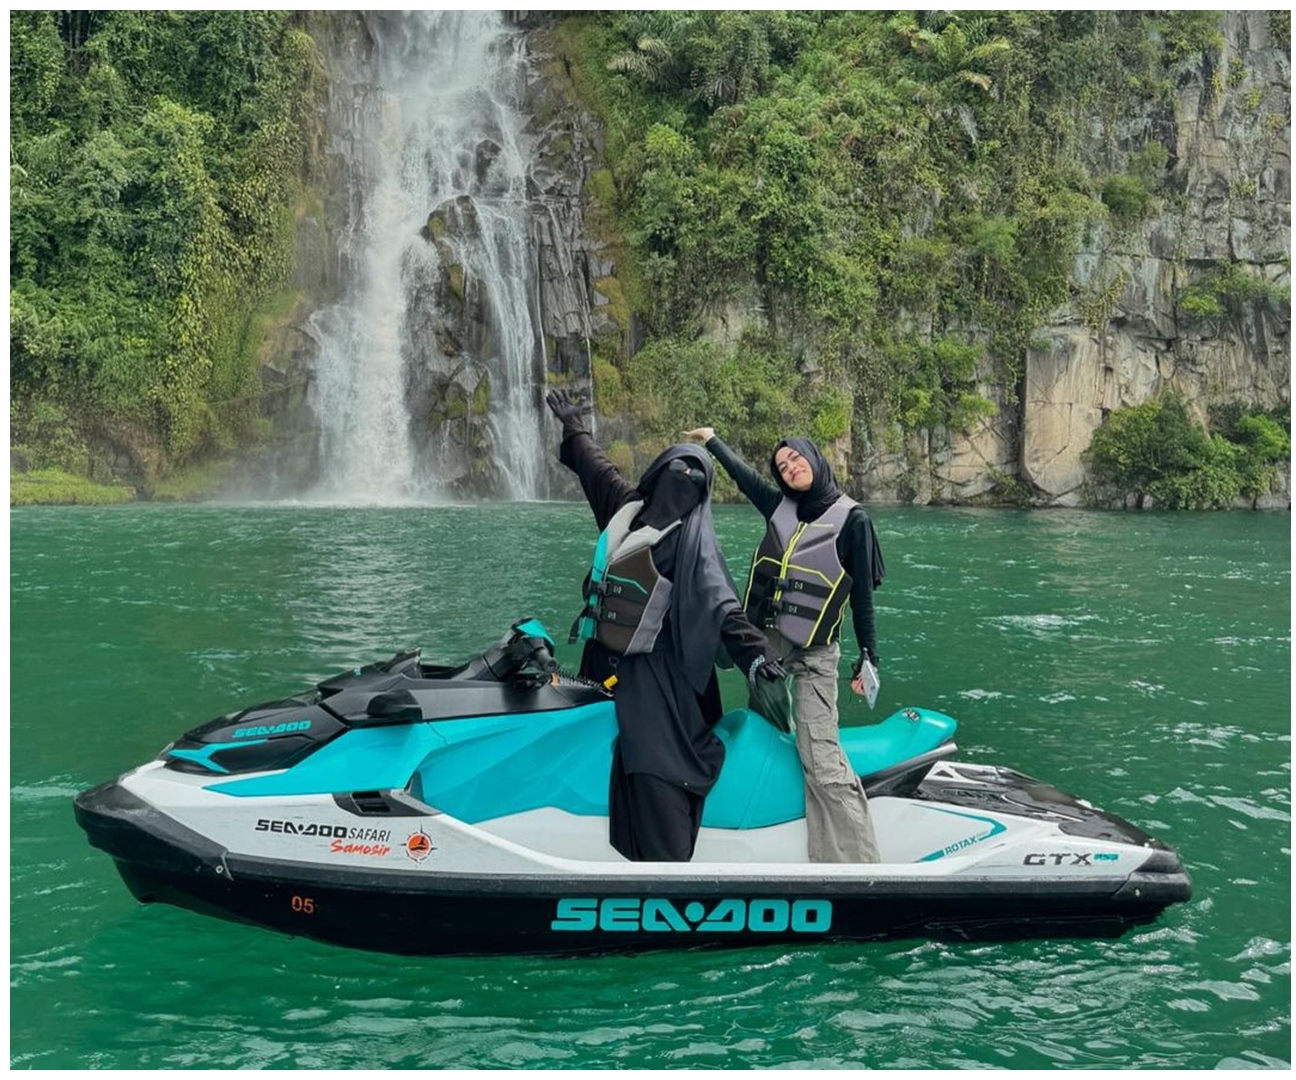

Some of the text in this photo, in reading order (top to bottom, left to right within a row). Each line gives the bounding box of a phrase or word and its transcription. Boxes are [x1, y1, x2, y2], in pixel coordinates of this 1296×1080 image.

[348, 827, 391, 842] SAFARI
[330, 839, 390, 857] Samosir
[944, 834, 977, 855] ROTAX
[1023, 853, 1092, 866] GTX
[292, 895, 314, 914] 05
